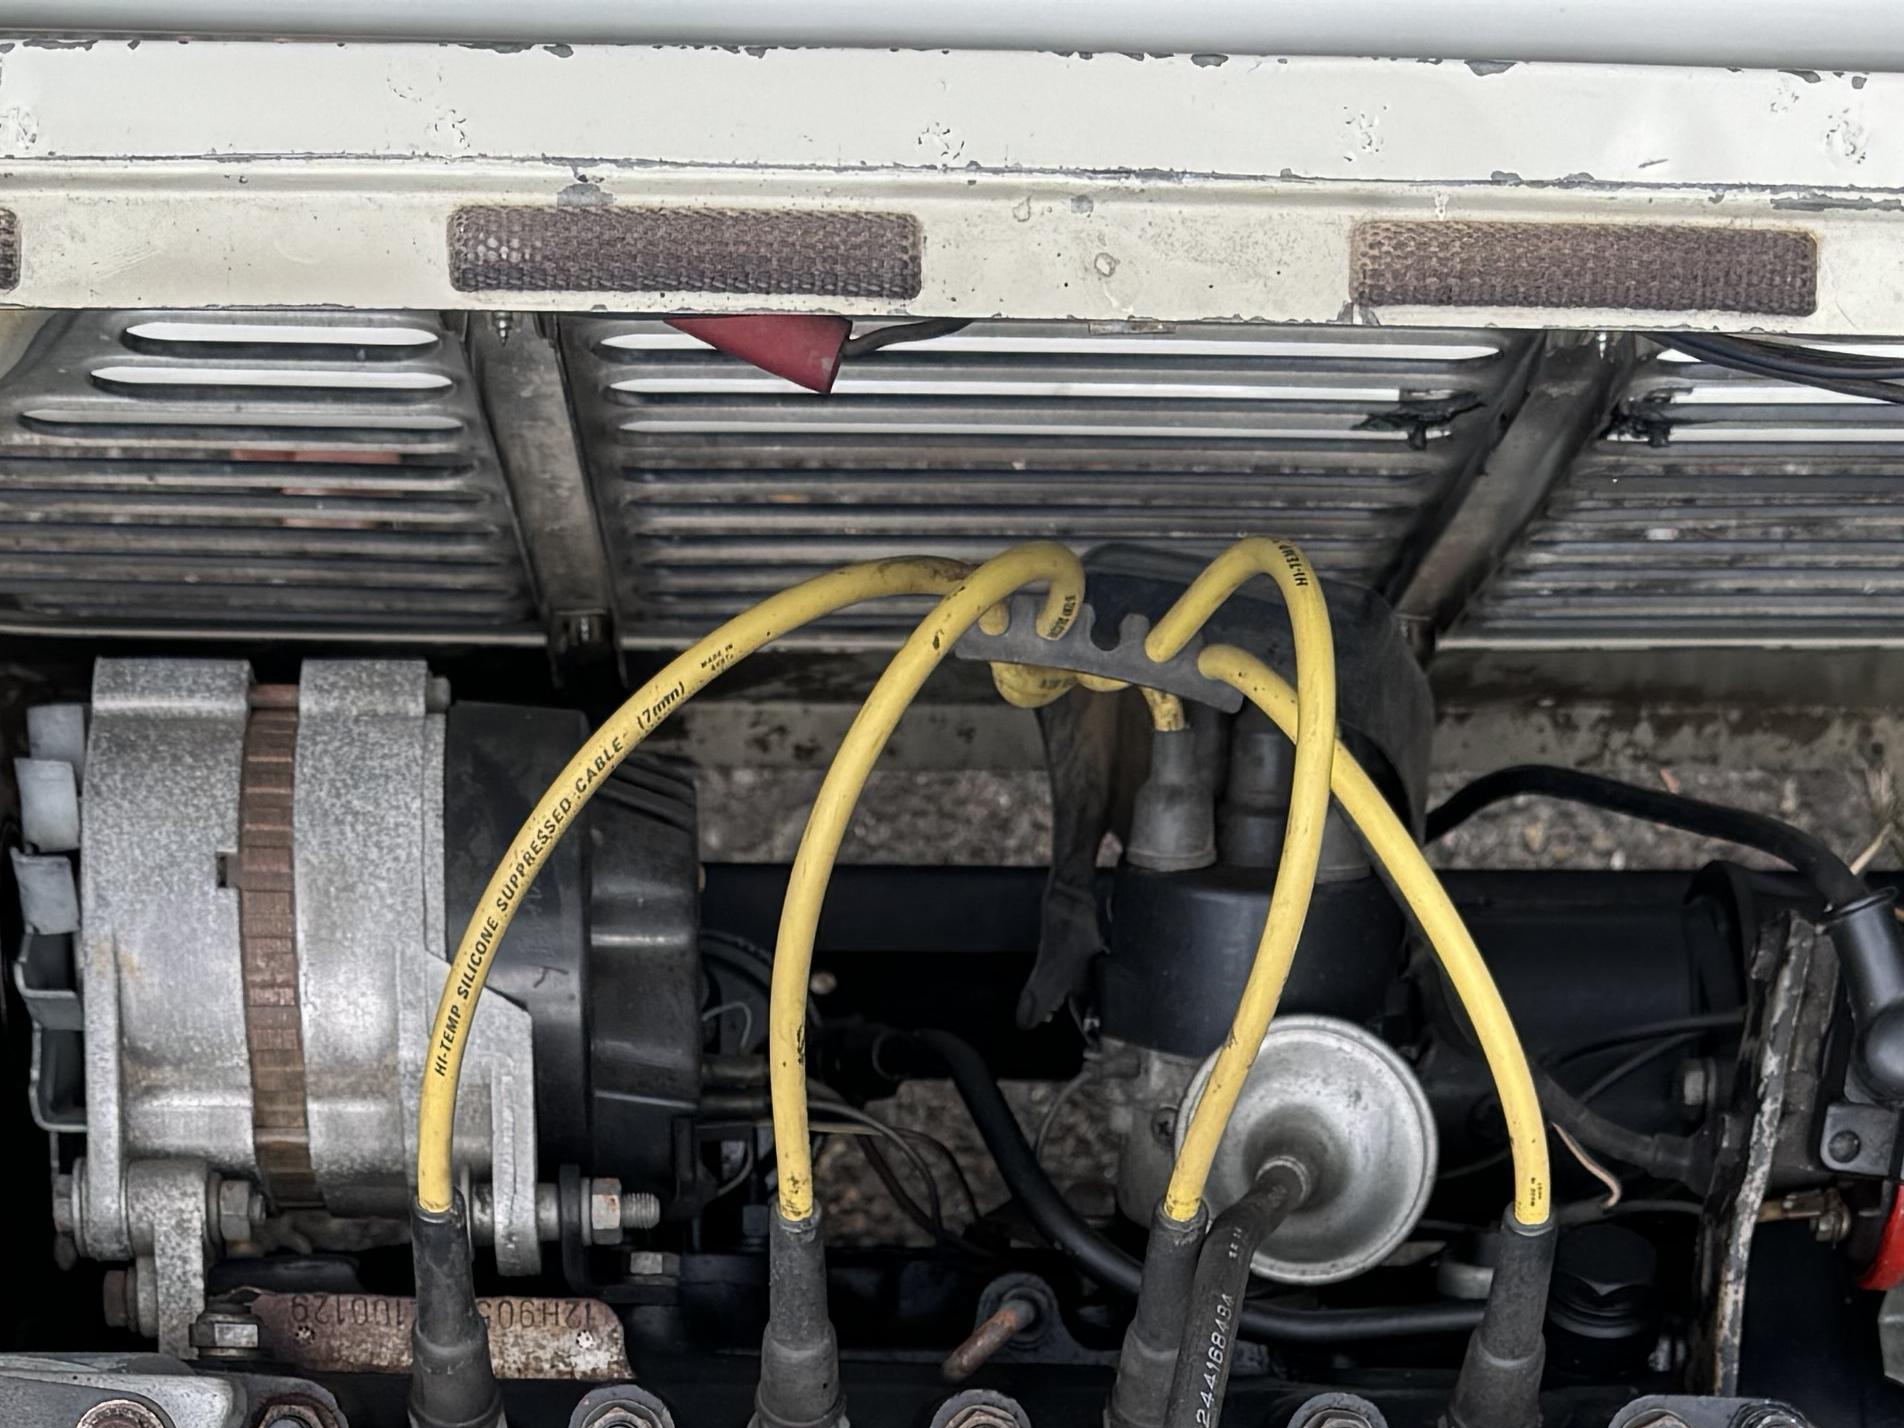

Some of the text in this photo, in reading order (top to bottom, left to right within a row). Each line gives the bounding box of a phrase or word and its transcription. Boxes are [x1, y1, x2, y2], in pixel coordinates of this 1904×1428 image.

[434, 1005, 462, 1077] HI-TEMP
[457, 916, 498, 1001] SILICONE
[496, 796, 572, 914] SUPPRESSED
[575, 736, 624, 796] CABLE
[636, 681, 687, 731] (7mm)
[290, 1294, 418, 1327] 100129
